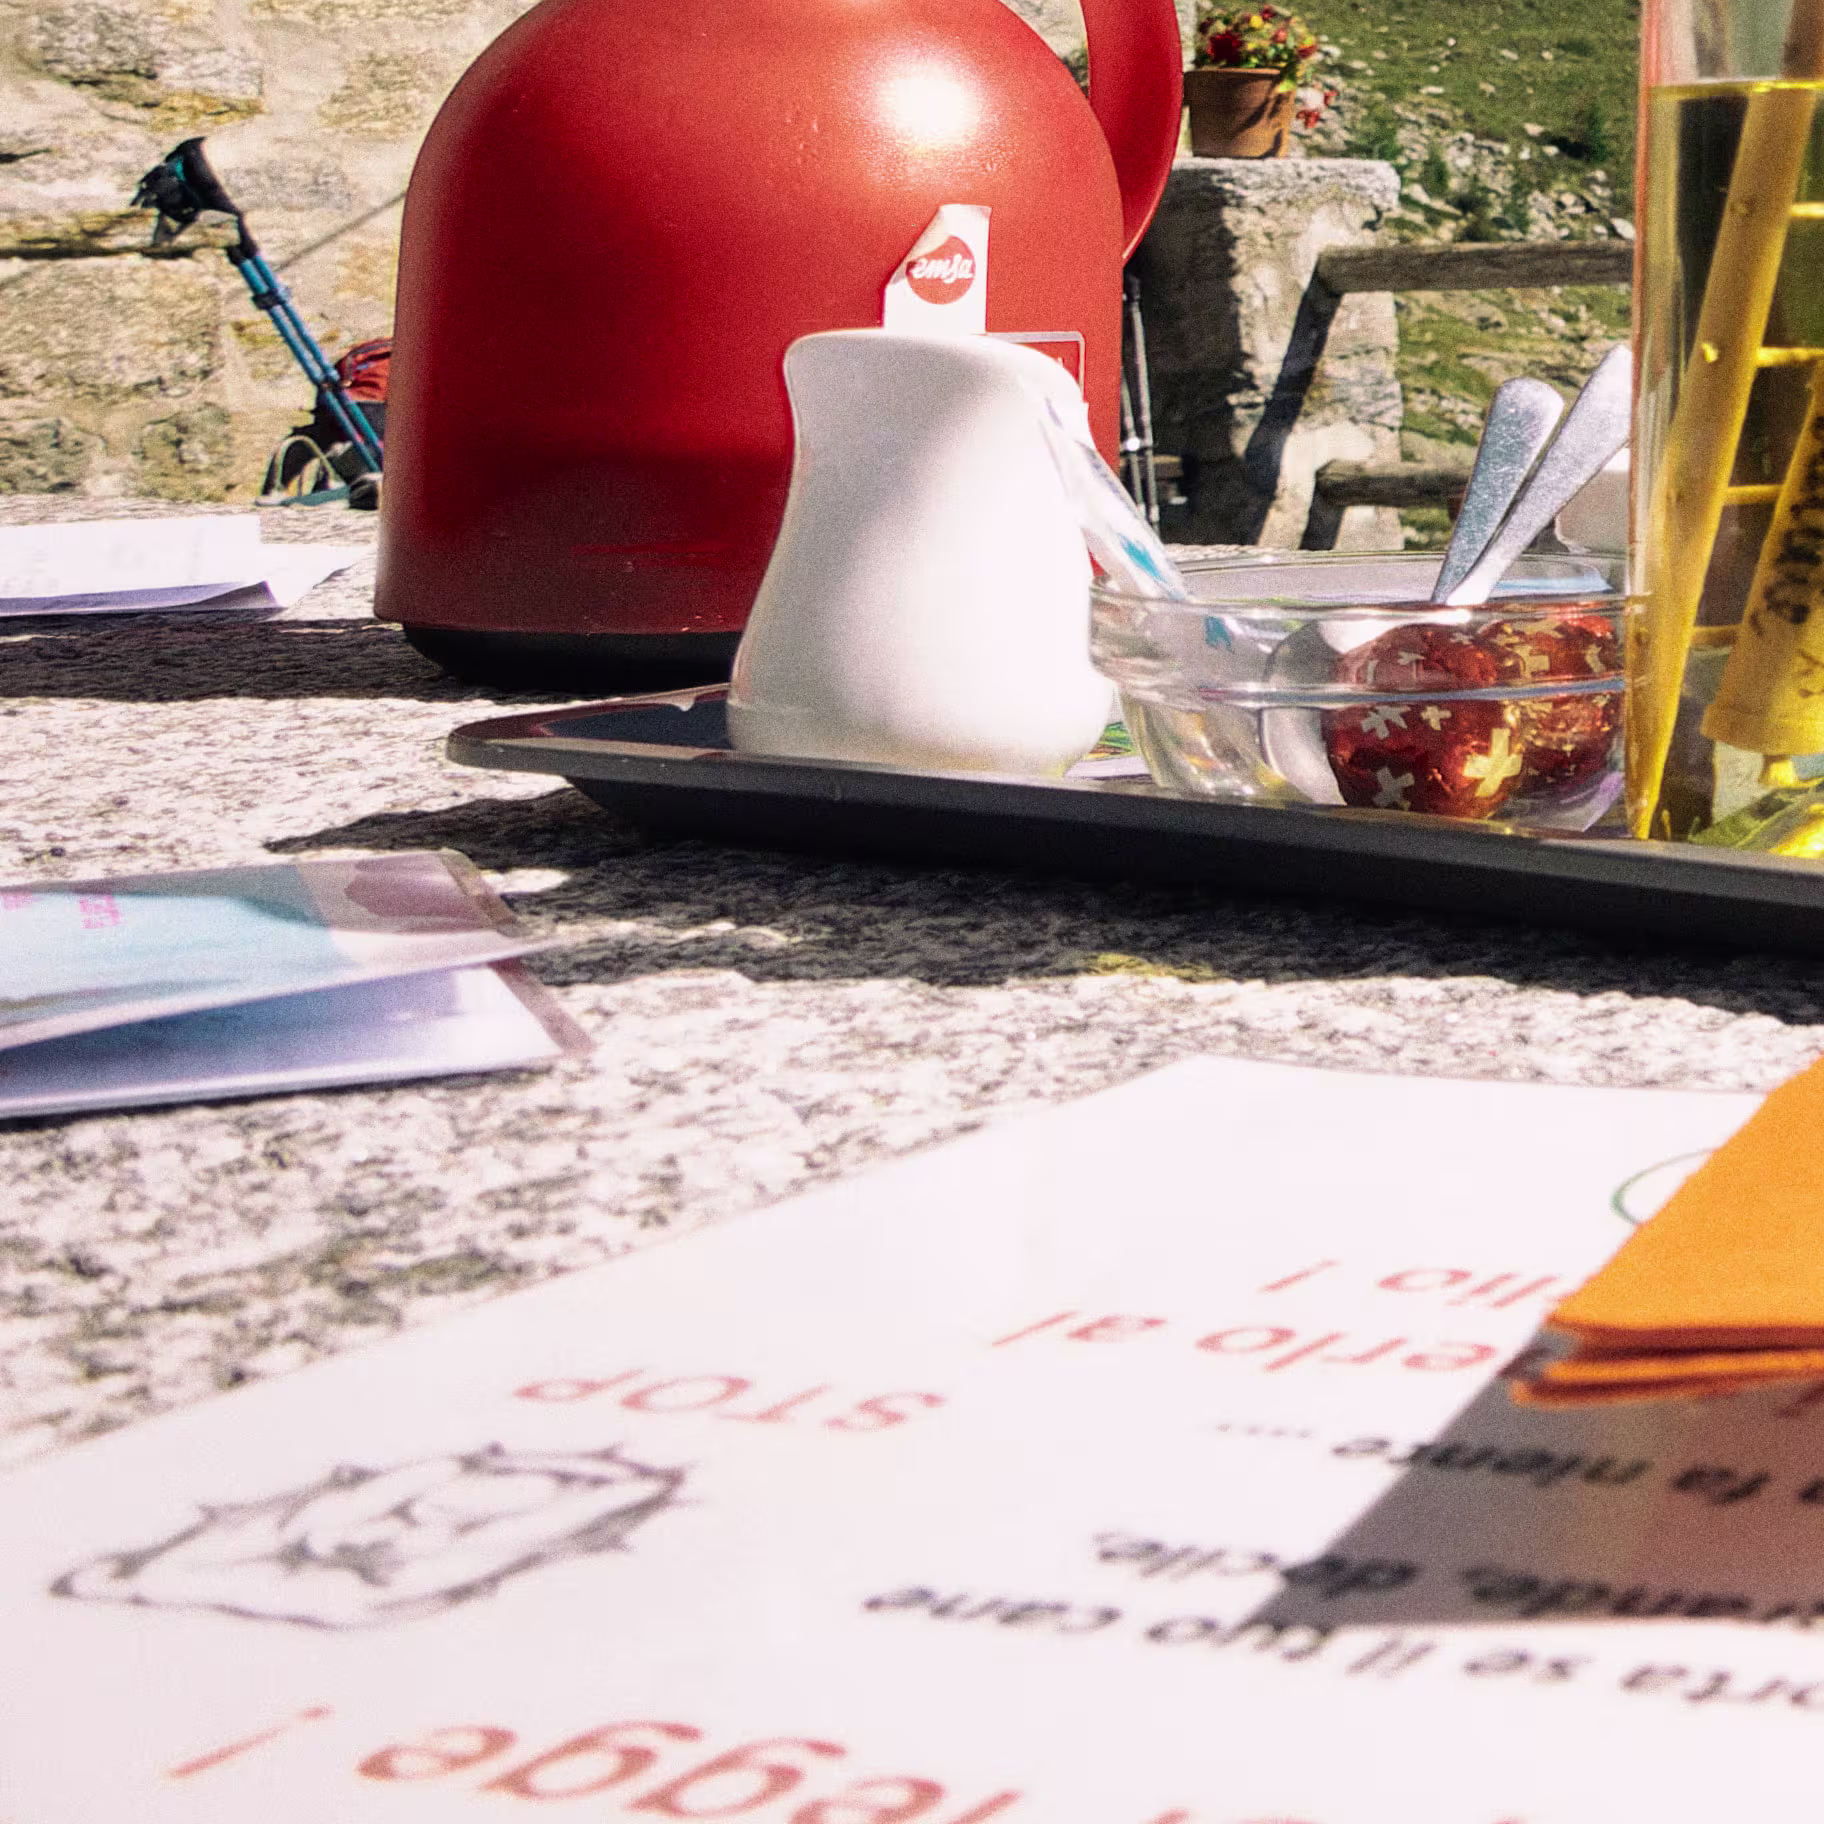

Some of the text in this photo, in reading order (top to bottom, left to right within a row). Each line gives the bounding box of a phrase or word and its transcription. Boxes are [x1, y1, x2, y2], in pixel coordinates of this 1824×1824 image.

[990, 1310, 1167, 1348] al
[511, 1368, 946, 1433] STOP
[1672, 1466, 1772, 1510] fa
[861, 1587, 1121, 1635] cane
[1144, 1618, 1334, 1665] tuo
[1345, 1634, 1435, 1680] il
[1463, 1650, 1593, 1687] se
